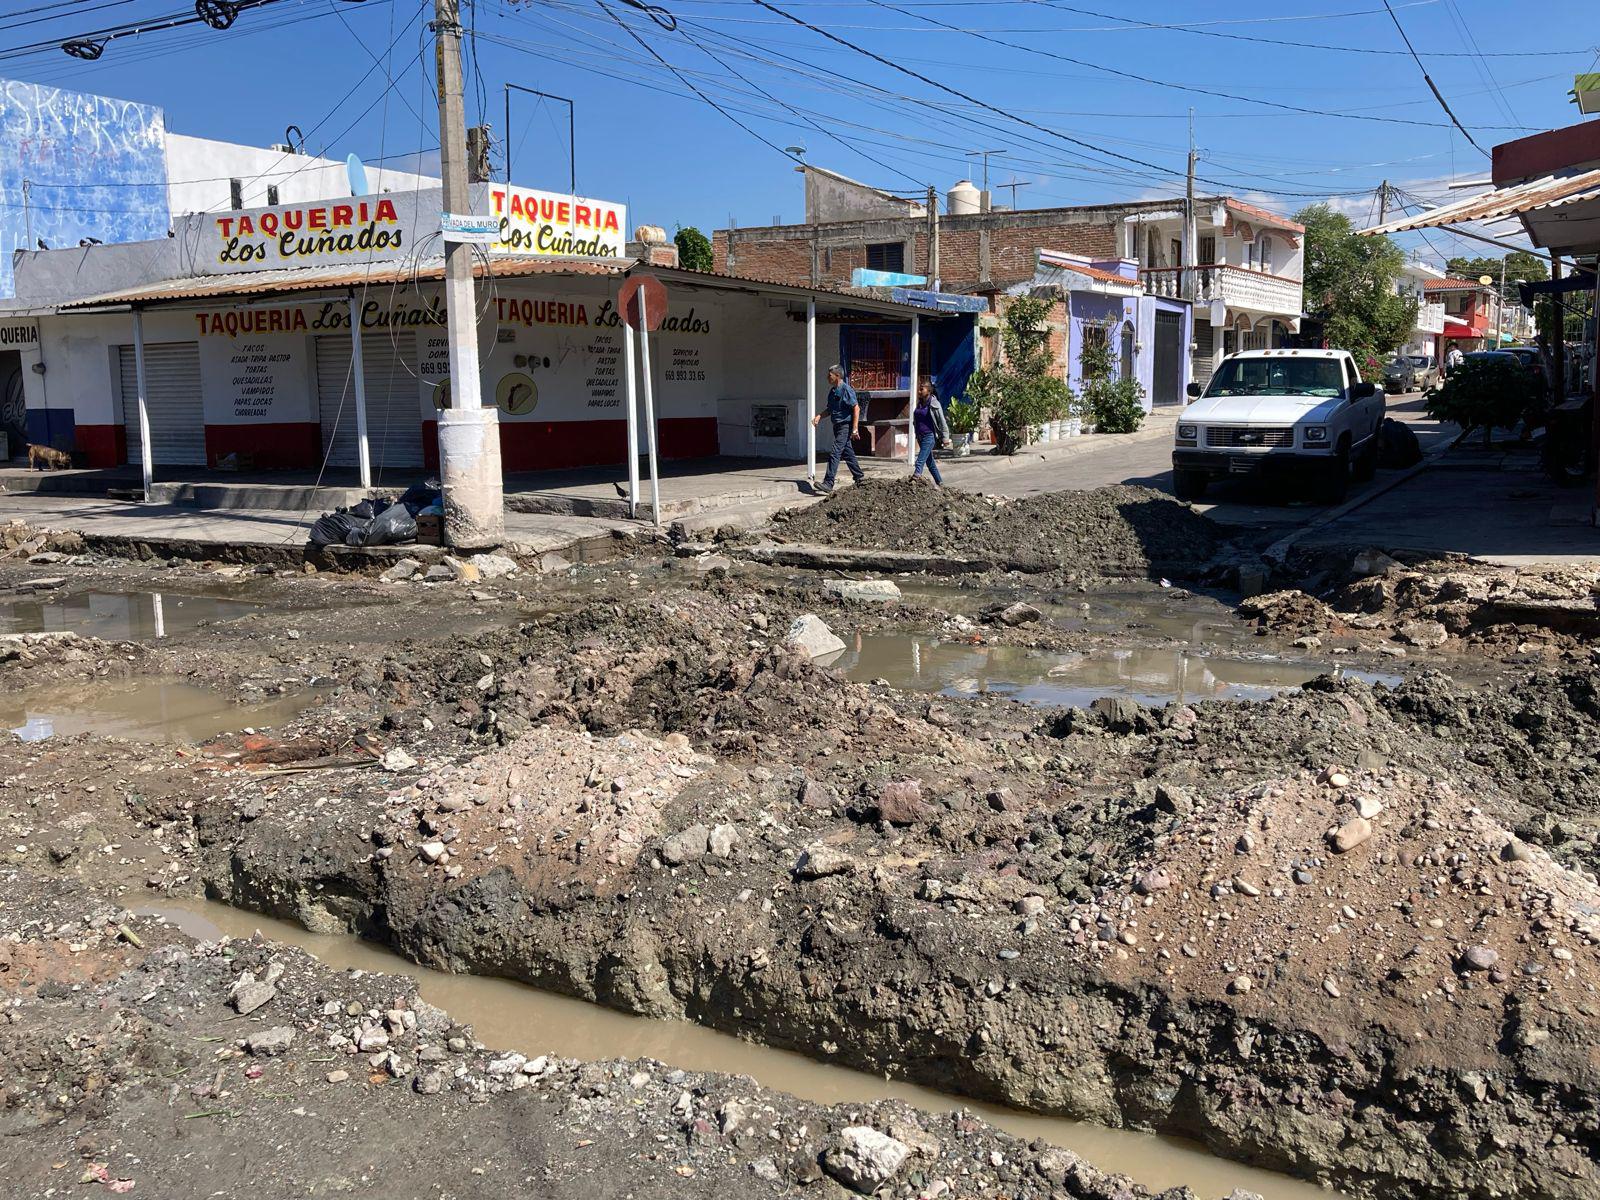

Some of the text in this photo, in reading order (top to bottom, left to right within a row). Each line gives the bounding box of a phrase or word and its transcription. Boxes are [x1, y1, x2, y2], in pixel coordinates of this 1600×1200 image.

[492, 190, 619, 231] TAQUERIA
[216, 199, 399, 238] TAQUERIA
[464, 220, 475, 228] DEL
[476, 220, 499, 229] MURO
[220, 221, 403, 264] Los Cuñados
[499, 216, 617, 257] Los Cuñados
[196, 308, 308, 337] TAQUERIA
[361, 295, 448, 328] Cuñado
[492, 297, 589, 327] TAQUERIA
[1, 325, 38, 345] QUERIA
[242, 344, 265, 353] TACOS
[427, 338, 449, 348] SERVI
[250, 354, 266, 363] TRIPA
[268, 353, 291, 363] PASTOR
[245, 365, 268, 374] TORTAS
[232, 375, 274, 386] QUESADILLAS
[234, 397, 274, 406] PAPAS LOCAS
